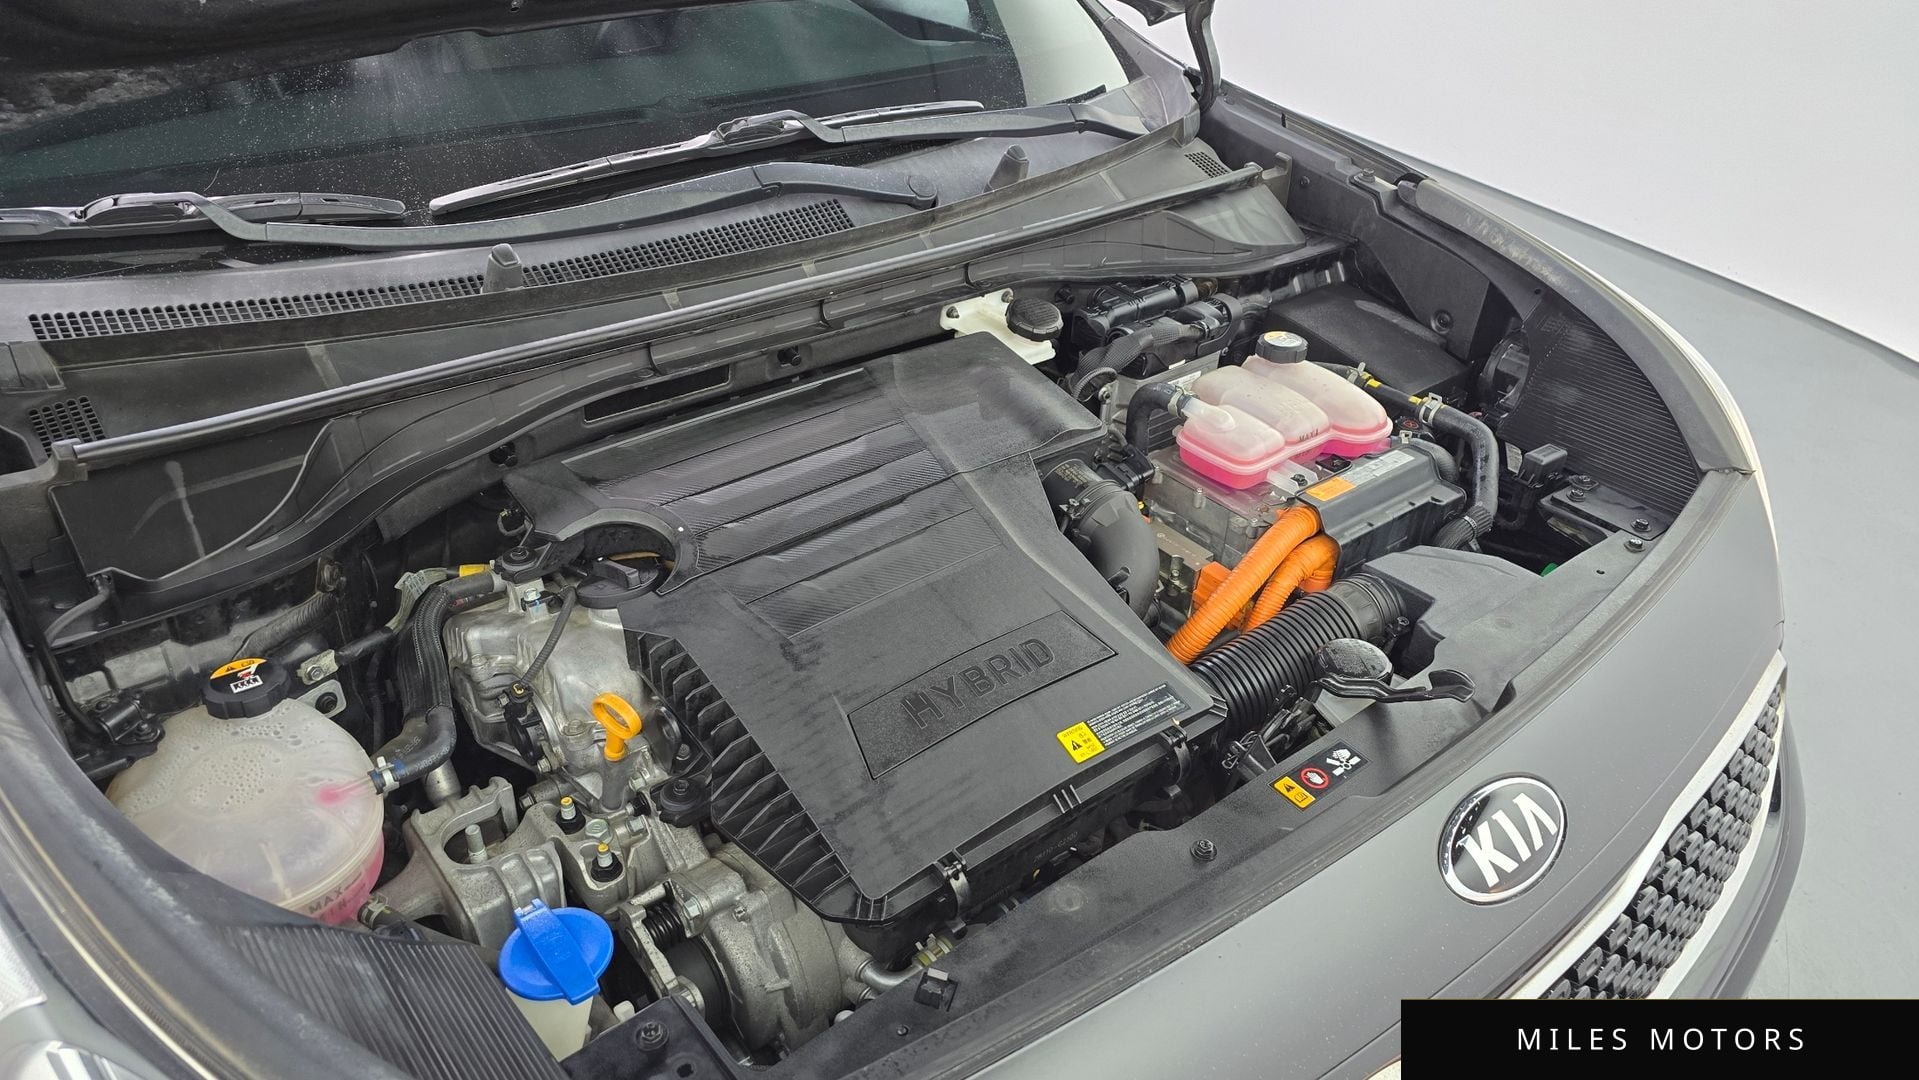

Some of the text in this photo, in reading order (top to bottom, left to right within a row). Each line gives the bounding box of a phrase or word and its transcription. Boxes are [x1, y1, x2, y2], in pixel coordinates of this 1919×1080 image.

[900, 638, 1055, 729] HYBRID
[1456, 792, 1558, 887] KIA
[308, 886, 343, 915] MAX
